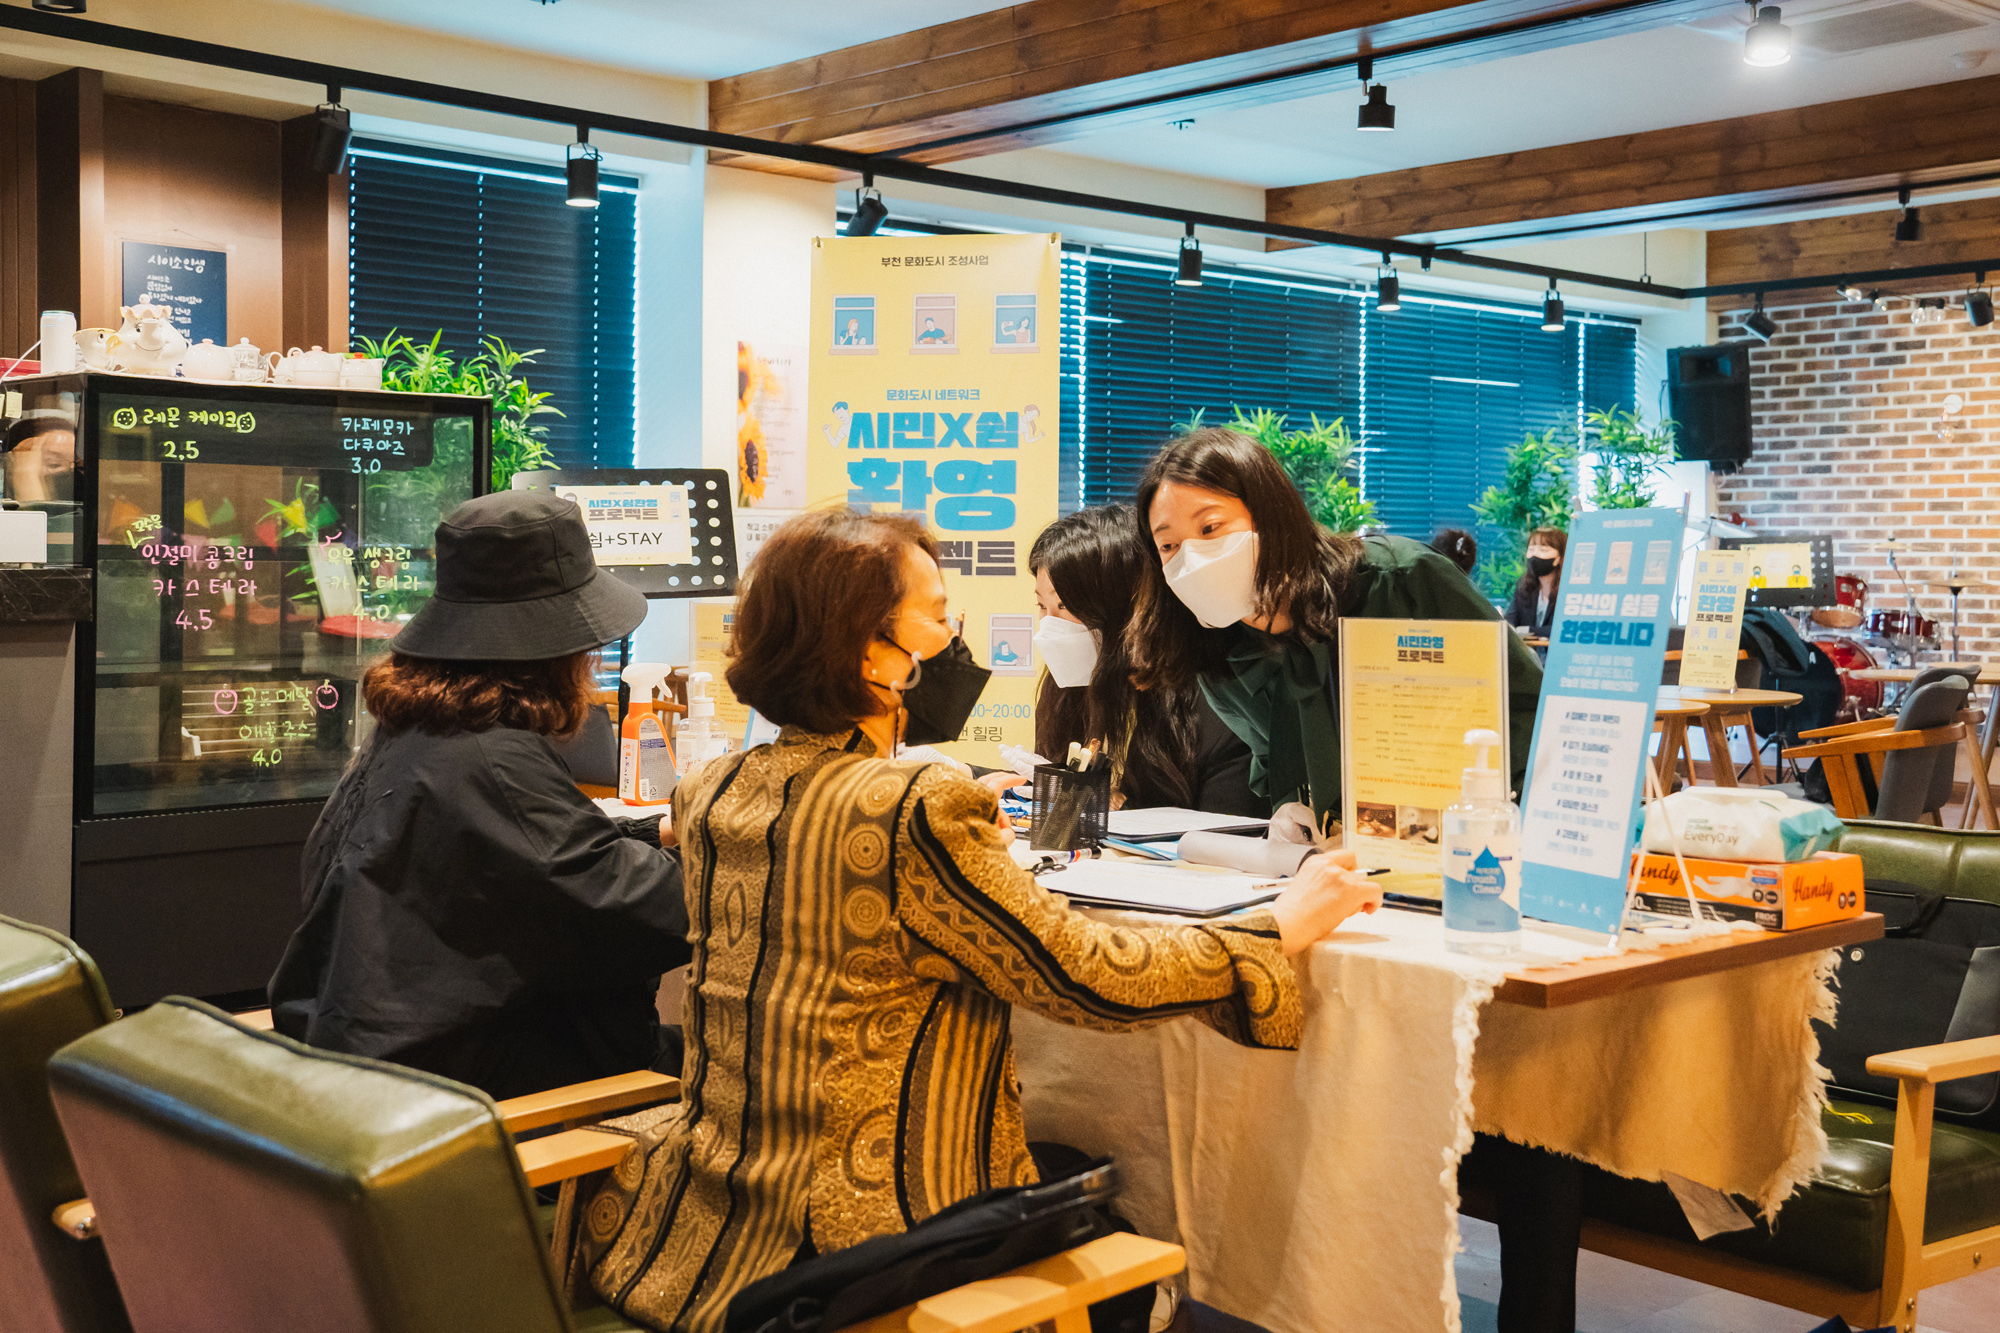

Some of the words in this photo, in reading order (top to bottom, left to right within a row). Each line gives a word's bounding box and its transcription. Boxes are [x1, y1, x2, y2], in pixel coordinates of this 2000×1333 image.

[881, 256, 901, 267] 부천
[904, 256, 945, 267] 문화도시
[948, 255, 989, 266] 조성사업
[886, 389, 932, 401] 문화도시
[935, 388, 981, 401] 네트워크
[143, 407, 181, 428] 레몬
[188, 410, 237, 428] 케이크
[341, 417, 415, 436] 카페모카
[343, 438, 406, 456] 다쿠아즈
[588, 508, 659, 521] 프로젝트
[141, 544, 197, 566] 인절미
[204, 546, 254, 570] 콩크림
[939, 541, 1017, 576] 젝트
[1563, 593, 1618, 616] 당신의
[1397, 635, 1444, 649] 시민환영
[1559, 620, 1655, 647] 환영합니다
[1397, 650, 1444, 664] 프로젝트
[972, 726, 1003, 742] 힐링
[252, 748, 282, 768] 4.0
